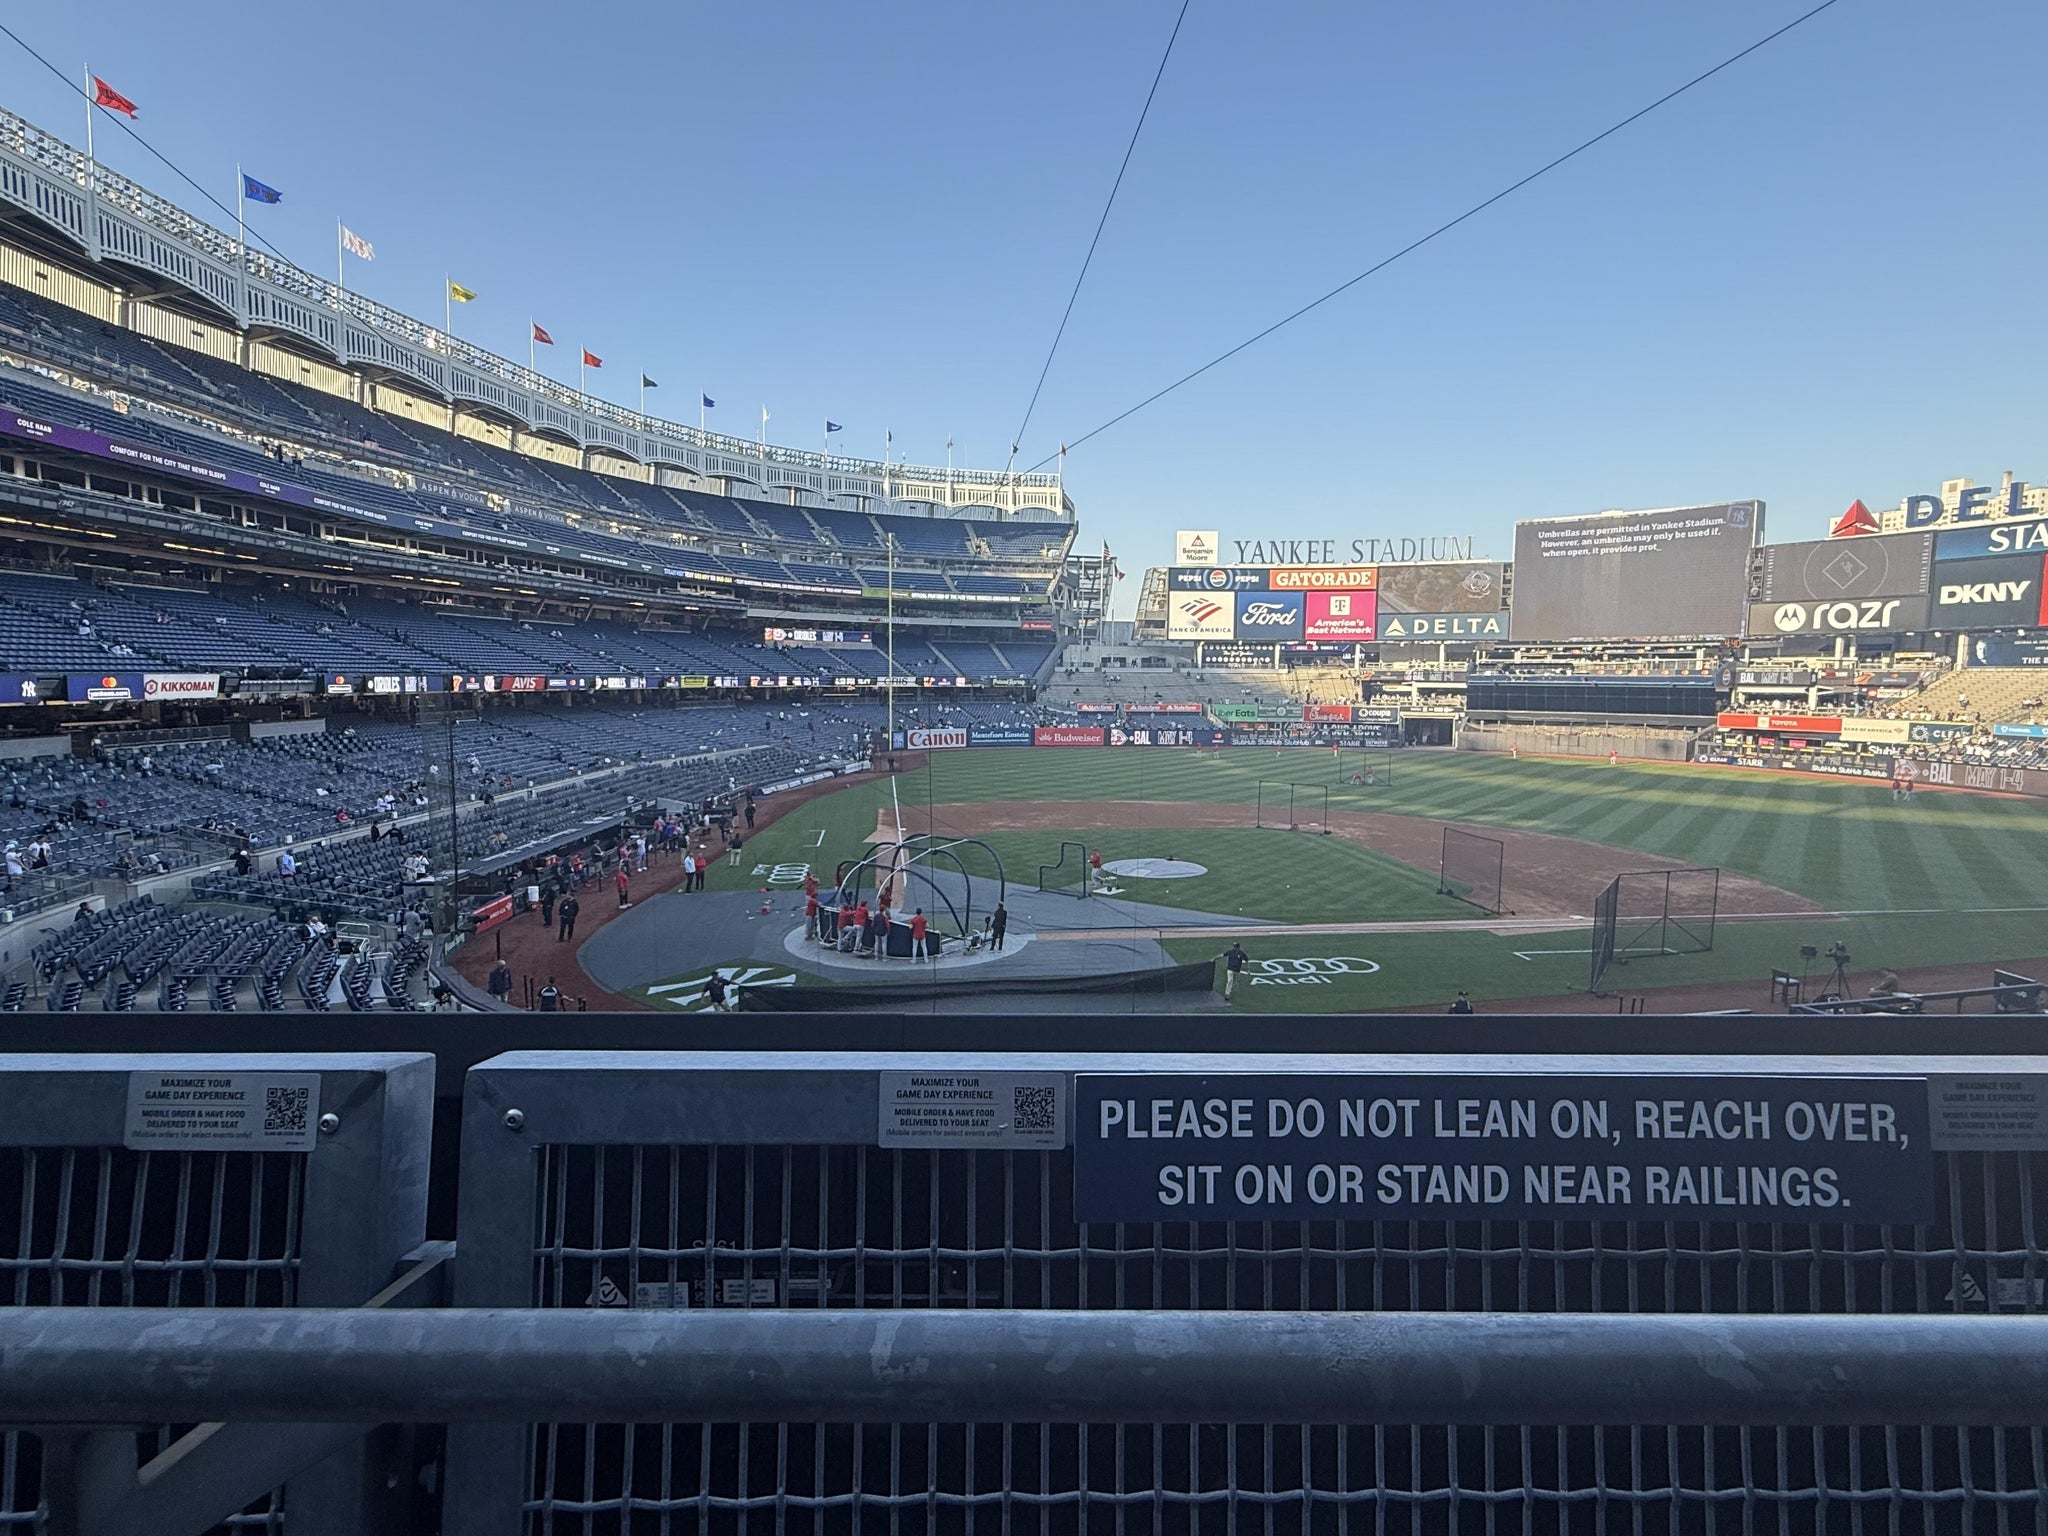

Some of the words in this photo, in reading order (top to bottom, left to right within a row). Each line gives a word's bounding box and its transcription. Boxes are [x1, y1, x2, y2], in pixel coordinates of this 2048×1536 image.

[17, 418, 34, 429] COLE
[110, 445, 138, 458] COMFORT
[139, 452, 151, 461] FOR
[152, 455, 163, 464] THE
[164, 458, 177, 467] CITY
[177, 461, 190, 471] THAT
[191, 466, 208, 476] NEVER
[208, 470, 226, 481] SLEEPS
[421, 483, 450, 498] ASPEN
[458, 491, 485, 504] VODKA
[515, 506, 538, 517] ASPEN
[1538, 530, 1580, 539] Umbrellas
[1581, 528, 1595, 536] are
[1596, 524, 1640, 536] permitted
[1641, 524, 1650, 532] in
[1651, 520, 1684, 531] Yankee
[1685, 518, 1726, 528] Stadium.
[1541, 539, 1580, 548] However,
[1594, 535, 1632, 545] umbrella
[1633, 534, 1652, 543] may
[1653, 531, 1674, 541] only
[1675, 531, 1686, 539] be
[1688, 528, 1710, 537] used
[1182, 548, 1213, 556] Benjamin
[1234, 540, 1335, 564] YANKEE
[1350, 536, 1475, 563] STADIUM
[1567, 548, 1591, 557] open,
[1600, 545, 1638, 555] provides
[1276, 571, 1372, 587] GATORADE
[1939, 580, 2031, 605] DKNY
[1242, 602, 1297, 625] Ford
[1813, 600, 1900, 629] razr
[1315, 619, 1365, 627] America's
[1413, 617, 1500, 634] DELTA
[1307, 626, 1329, 634] Best
[1330, 627, 1372, 635] Network
[512, 677, 537, 689] AVIS
[1740, 672, 1755, 684] BAL
[1761, 671, 1779, 684] MAY
[161, 681, 215, 692] KIKKOMAN
[1235, 709, 1256, 718] Eats
[1368, 709, 1392, 718] coupa
[909, 731, 965, 747] Canon
[971, 731, 1004, 739] Montefiore
[1004, 731, 1030, 739] Einstein
[1054, 734, 1101, 743] Budweiser
[1134, 731, 1151, 745] BAL
[1158, 731, 1177, 745] MAY
[1179, 731, 1193, 745] 1-4
[1737, 758, 1764, 767] STARR
[1811, 765, 1837, 773] StubHub
[1838, 766, 1862, 775] StubHub
[1863, 769, 1888, 778] StubHub
[1929, 763, 1954, 784] BAL
[1965, 765, 1997, 788] MAY
[2000, 768, 2024, 791] 1-4
[1250, 975, 1333, 986] Audi
[161, 1079, 206, 1088] MAXIMIZE
[207, 1079, 231, 1088] YOUR
[911, 1078, 954, 1087] MAXIMIZE
[956, 1078, 979, 1087] YOUR
[145, 1091, 171, 1100] GAME
[173, 1091, 191, 1100] DAY
[193, 1091, 246, 1100] EXPERIENCE
[896, 1090, 922, 1099] GAME
[923, 1090, 941, 1099] DAY
[943, 1090, 994, 1099] EXPERIENCE
[141, 1110, 170, 1118] MOBILE
[171, 1110, 196, 1118] ORDER
[197, 1110, 203, 1118] &
[204, 1110, 224, 1118] HAVE
[226, 1110, 246, 1118] FOOD
[894, 1108, 922, 1117] MOBILE
[923, 1108, 947, 1117] ORDER
[948, 1108, 954, 1117] &
[955, 1108, 974, 1117] HAVE
[975, 1108, 995, 1117] FOOD
[146, 1120, 186, 1129] DELIVERED
[187, 1120, 197, 1129] TO
[198, 1120, 219, 1129] YOUR
[220, 1120, 239, 1129] SEAT
[899, 1118, 938, 1127] DELIVERED
[939, 1118, 949, 1127] TO
[950, 1118, 970, 1127] YOUR
[971, 1118, 989, 1127] SEAT
[1100, 1098, 1254, 1139] PLEASE
[1268, 1098, 1325, 1139] DO
[1339, 1098, 1420, 1138] NOT
[1435, 1098, 1536, 1138] LEAN
[1550, 1099, 1621, 1147] ON,
[1636, 1099, 1771, 1140] REACH
[1784, 1101, 1909, 1151] OVER,
[161, 1130, 180, 1139] orders
[181, 1130, 190, 1139] for
[191, 1130, 212, 1139] select
[213, 1130, 234, 1139] events
[911, 1129, 932, 1137] orders
[933, 1129, 942, 1137] for
[943, 1129, 963, 1137] select
[964, 1129, 985, 1137] events
[1158, 1164, 1222, 1206] SIT
[1235, 1164, 1292, 1205] ON
[1307, 1164, 1364, 1205] OR
[1377, 1163, 1510, 1205] STAND
[1524, 1165, 1632, 1204] NEAR
[1646, 1166, 1851, 1207] RAILINGS.
